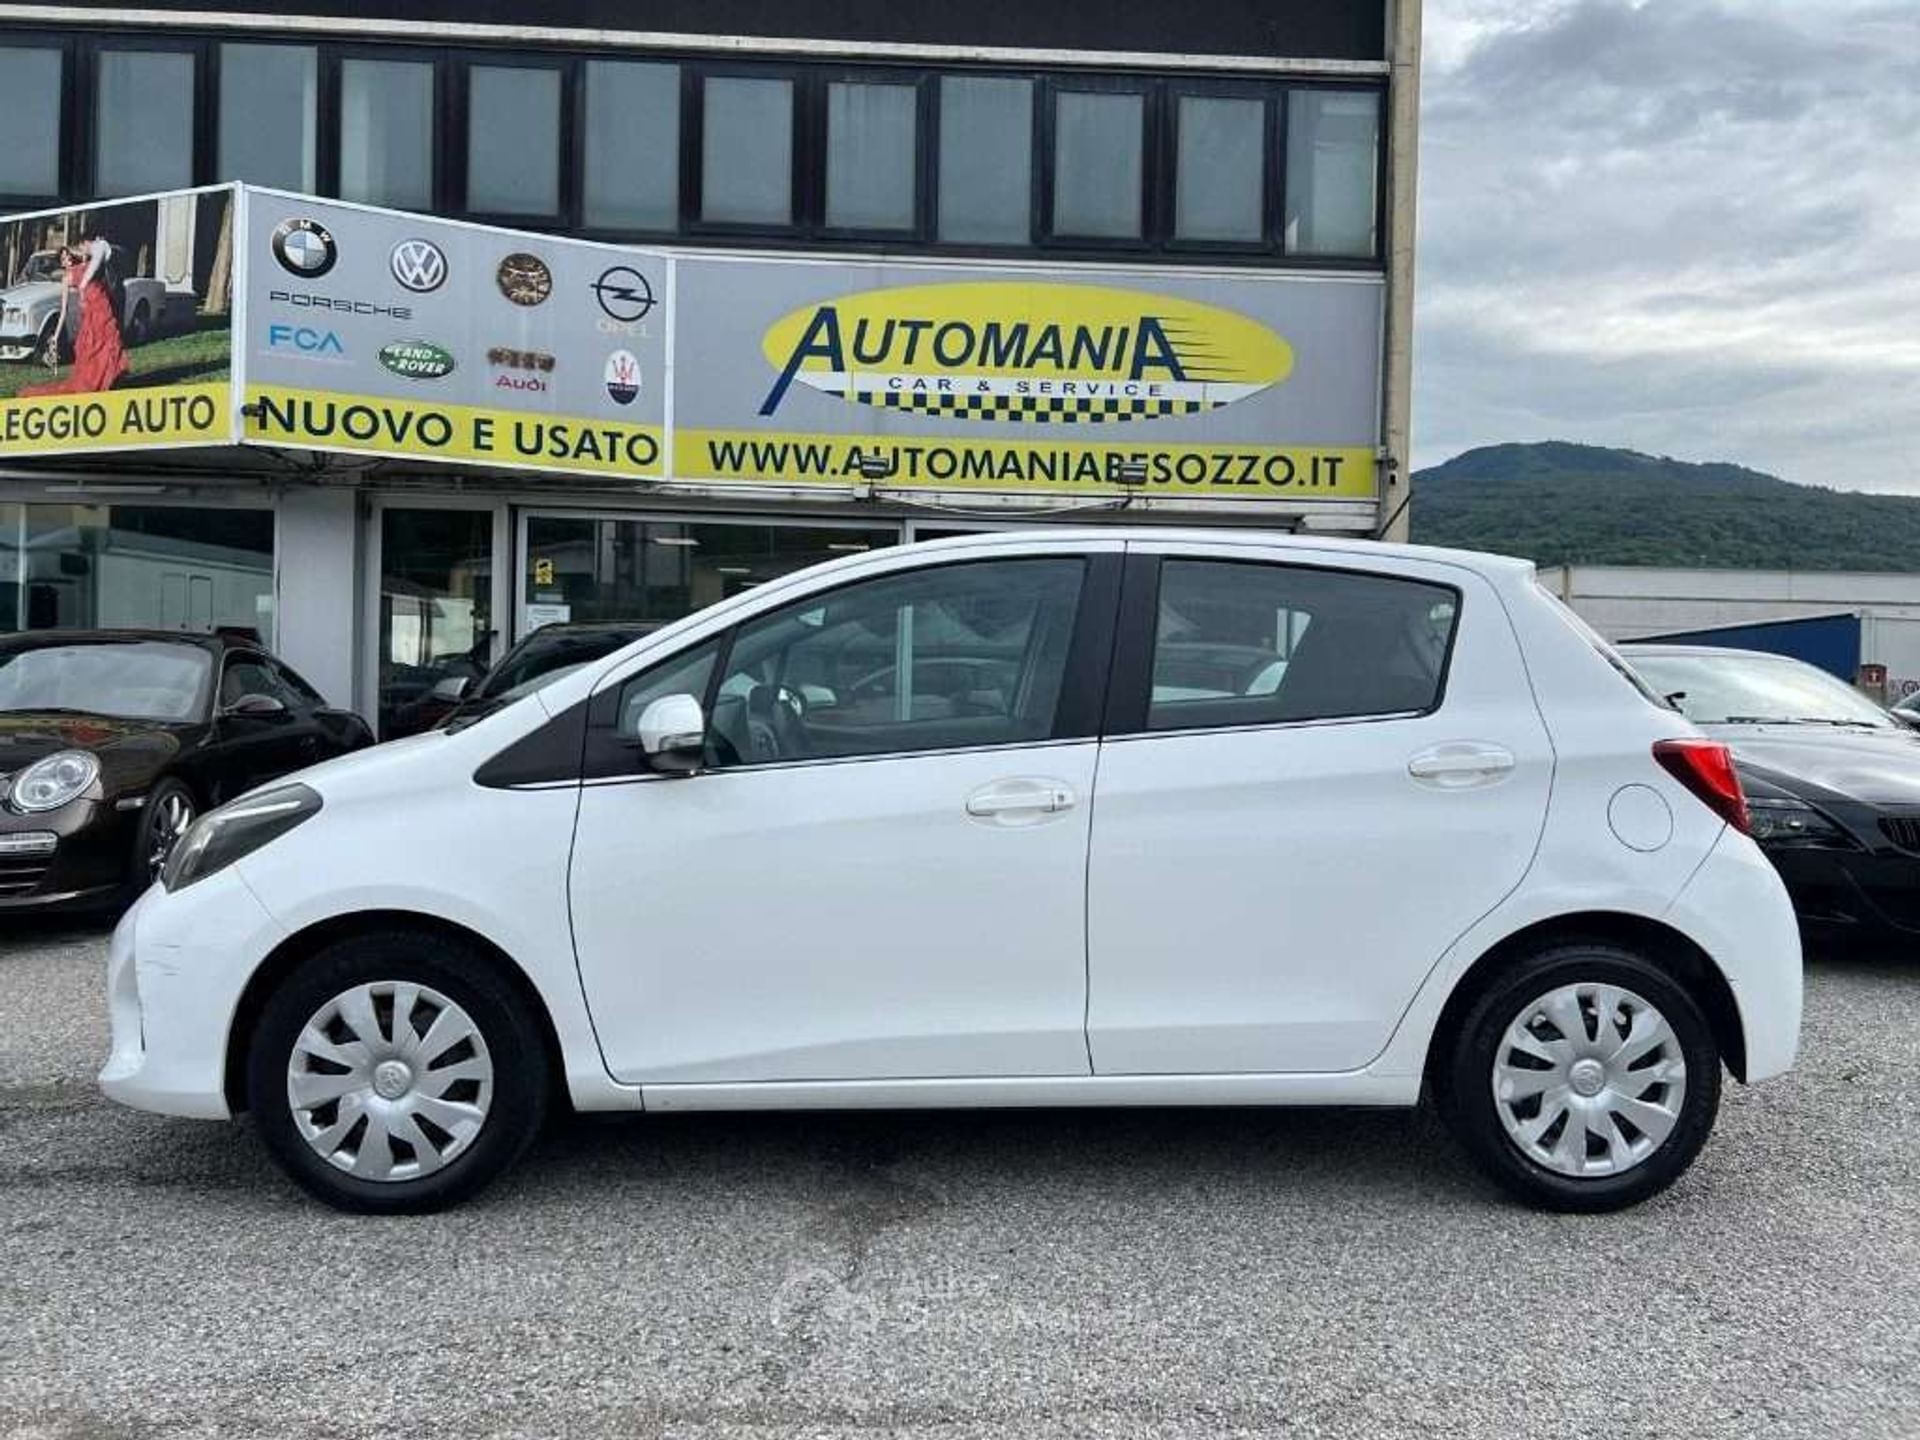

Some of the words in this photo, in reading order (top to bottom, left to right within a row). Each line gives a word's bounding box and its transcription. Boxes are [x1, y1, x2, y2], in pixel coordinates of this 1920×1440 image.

[270, 291, 412, 319] PORSCHE
[270, 325, 343, 353] FCA
[393, 346, 433, 360] LAND
[399, 358, 446, 374] ROVER
[888, 377, 952, 391] CAR
[976, 380, 990, 392] &
[1016, 380, 1161, 396] SERVICE
[0, 403, 106, 441] EGGIO
[121, 395, 215, 434] AUTO
[258, 395, 453, 447] NUOVO
[473, 418, 494, 451] E
[515, 422, 659, 466] USATO
